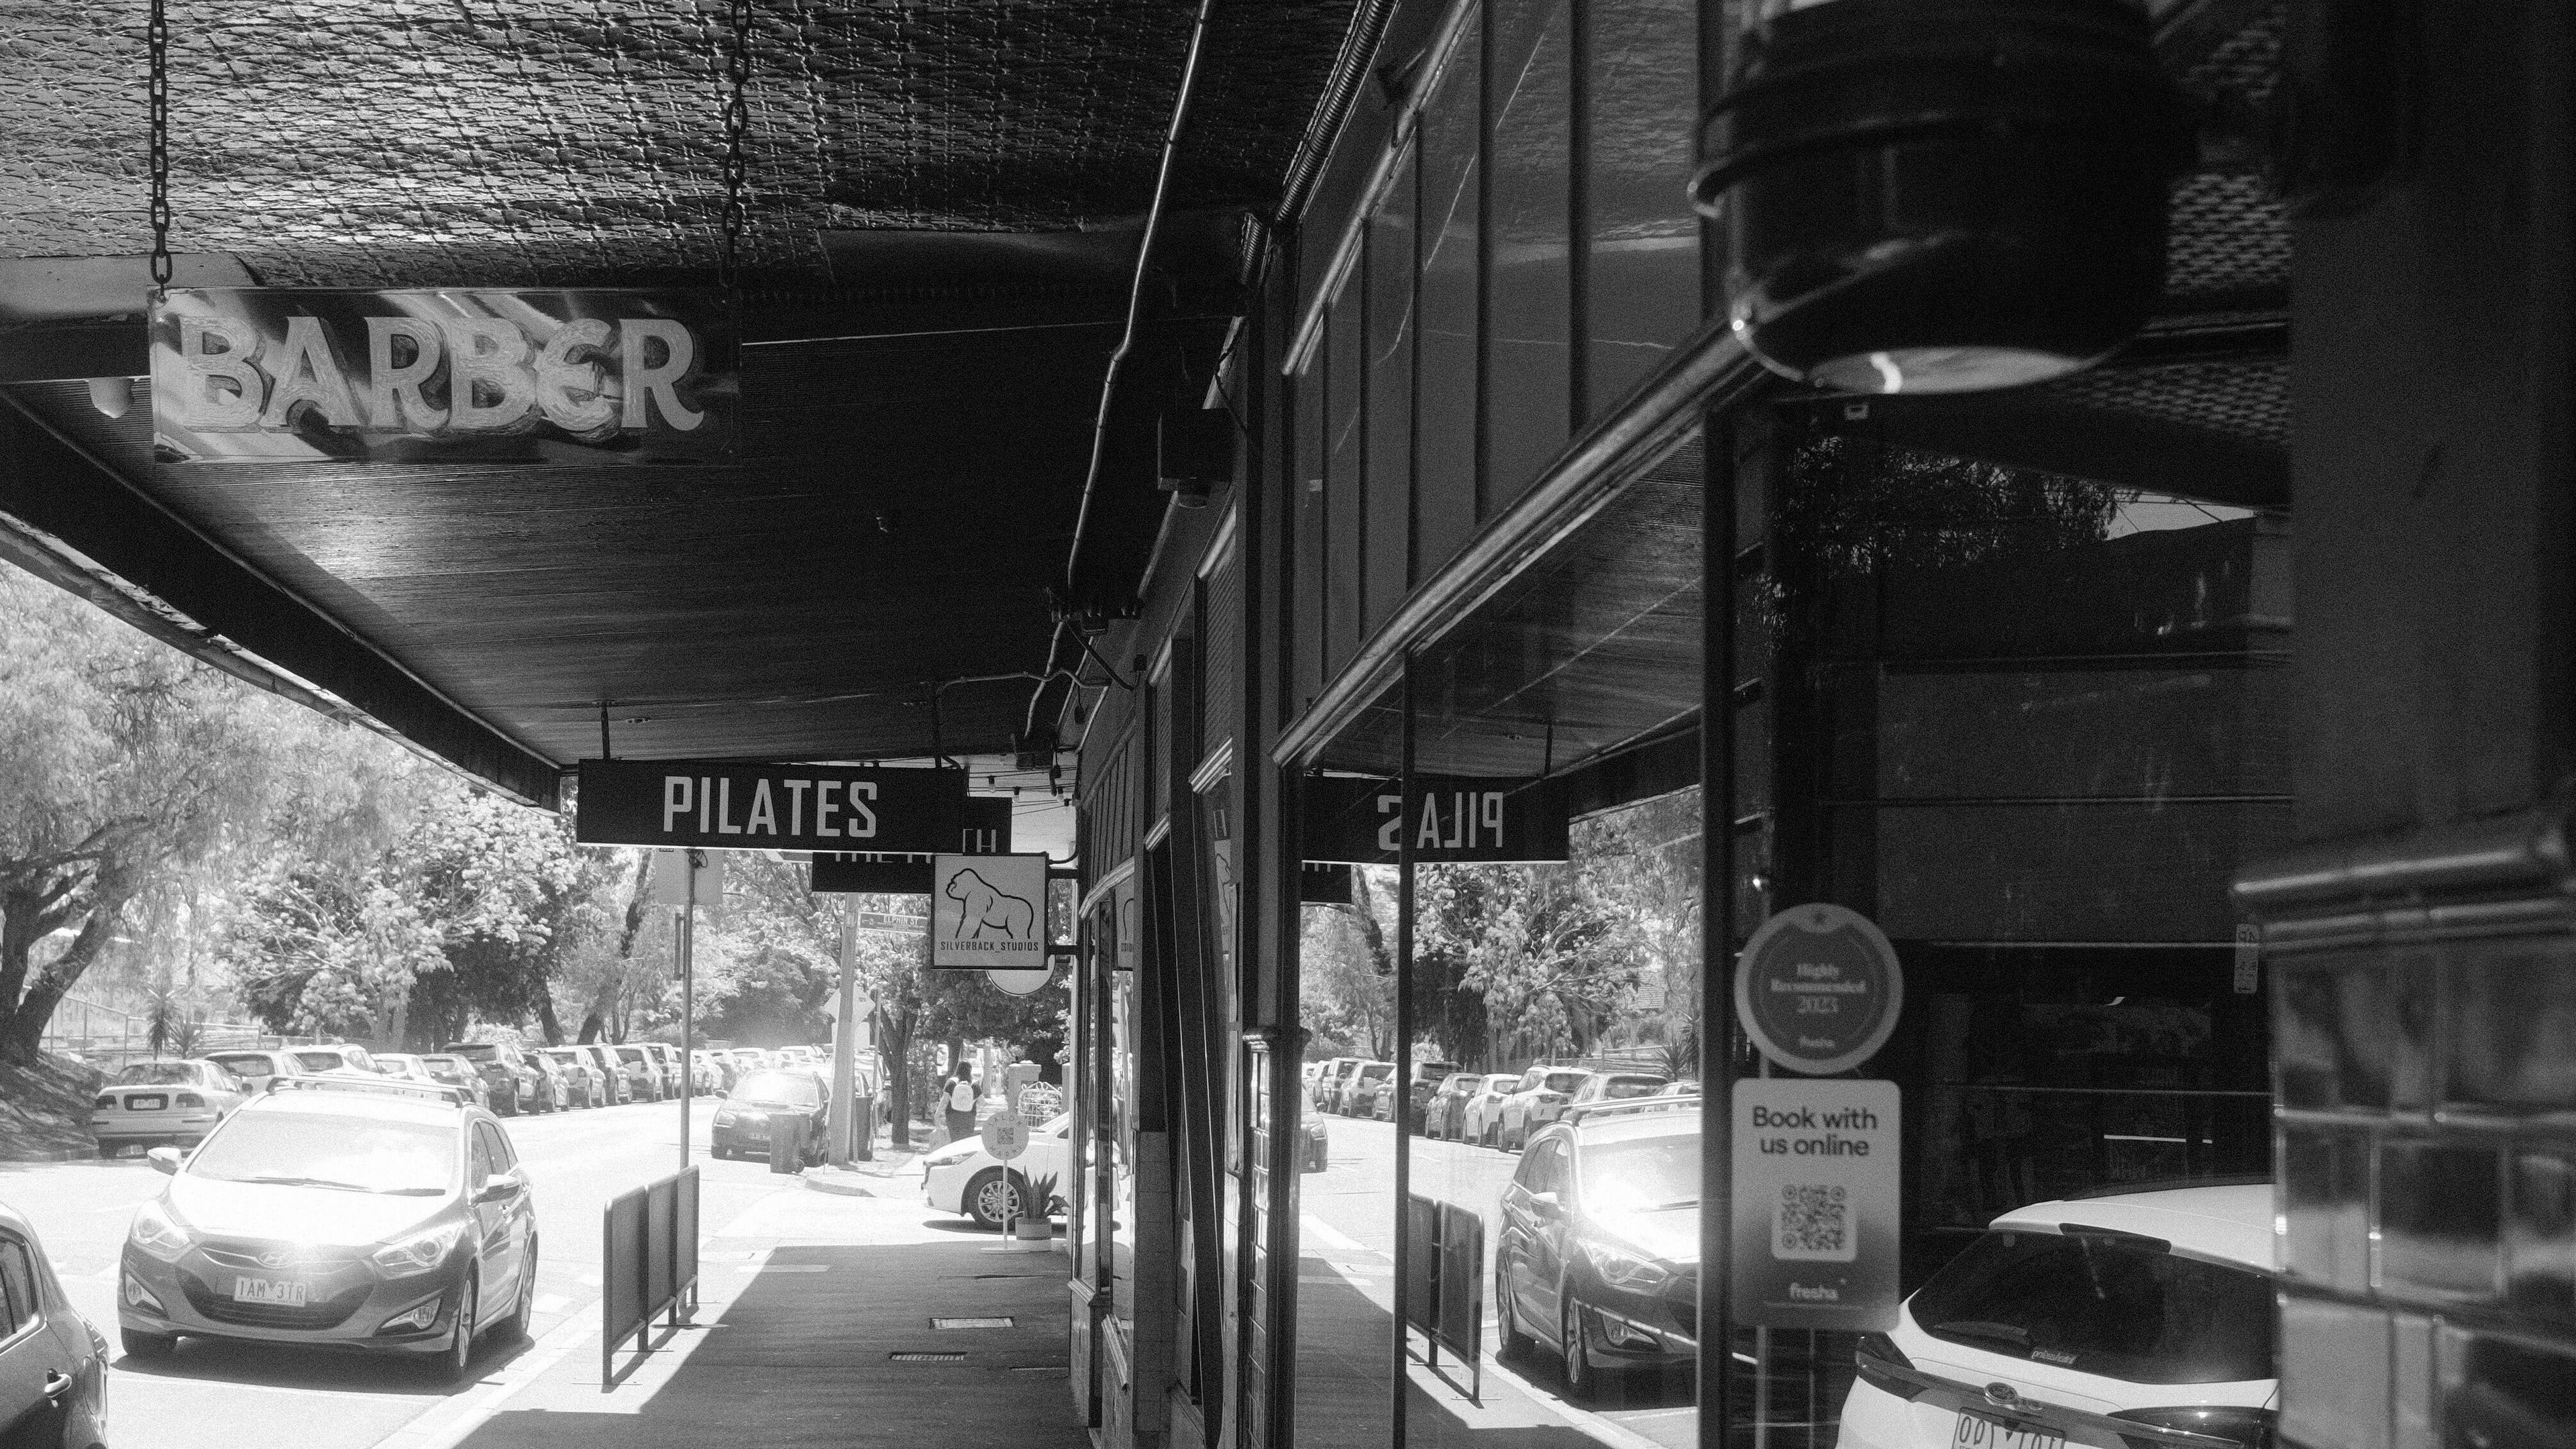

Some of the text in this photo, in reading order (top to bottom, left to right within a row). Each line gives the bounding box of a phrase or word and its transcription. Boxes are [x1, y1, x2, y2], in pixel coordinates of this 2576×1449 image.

[180, 315, 706, 435] BARBER
[663, 776, 877, 838] PILATES
[883, 915, 908, 924] ELPHIN
[910, 917, 918, 925] ST
[1752, 1106, 1877, 1129] Book with
[1760, 1133, 1870, 1156] us online
[1789, 1283, 1839, 1300] fresha
